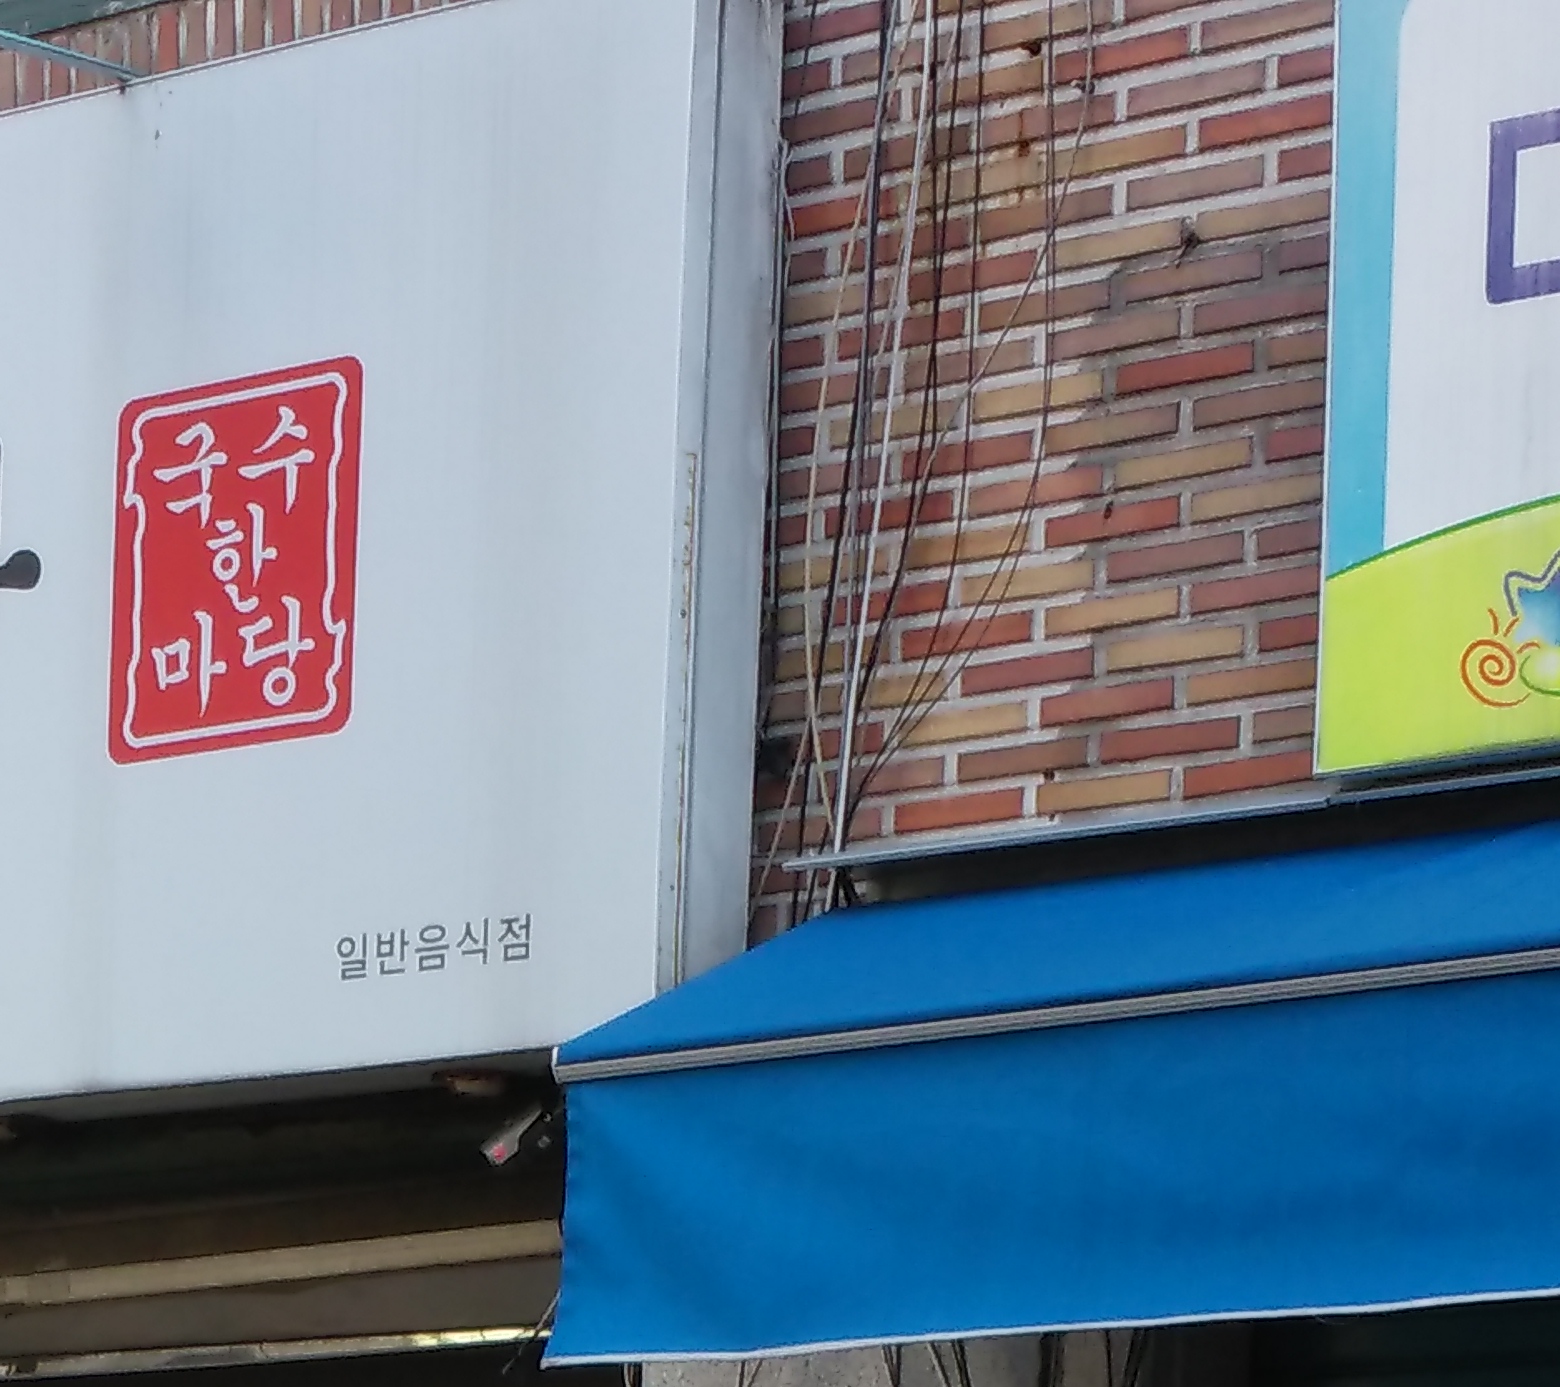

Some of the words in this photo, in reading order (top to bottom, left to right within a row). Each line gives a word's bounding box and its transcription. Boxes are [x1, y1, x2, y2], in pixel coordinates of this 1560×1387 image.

[153, 405, 315, 530] 국수
[206, 503, 278, 612] 한
[151, 595, 315, 719] 마당
[335, 913, 533, 981] 일반음식점
